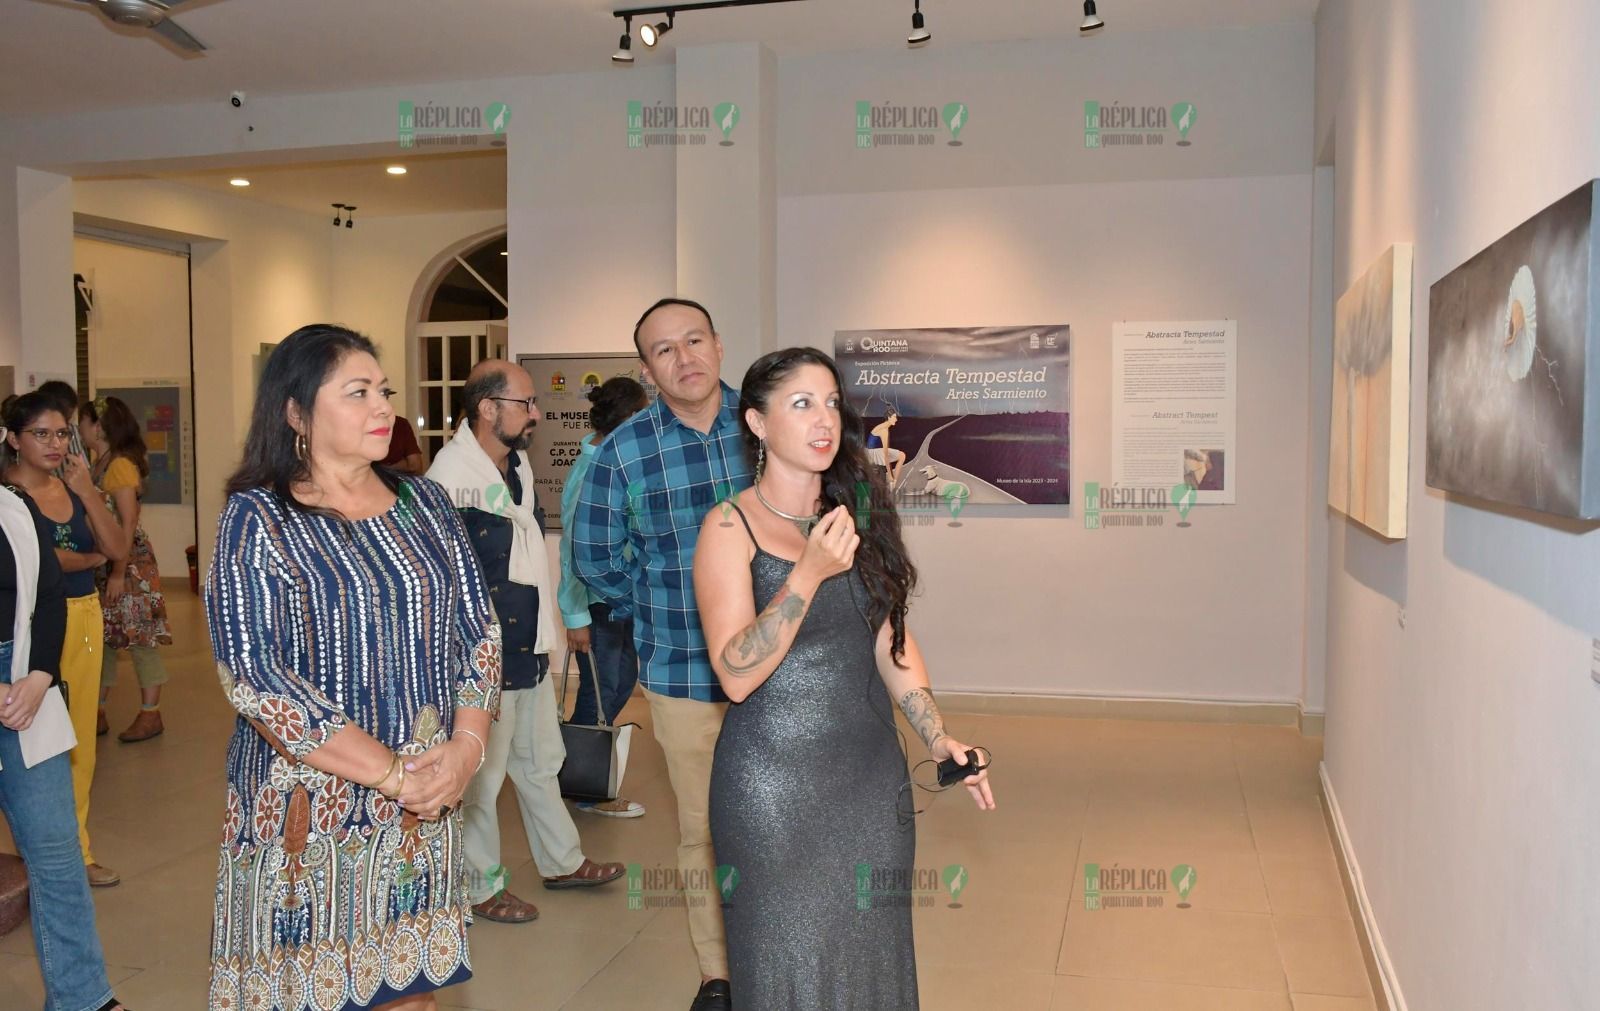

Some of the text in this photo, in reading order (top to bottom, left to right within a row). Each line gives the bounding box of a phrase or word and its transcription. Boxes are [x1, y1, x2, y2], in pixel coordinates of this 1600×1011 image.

[1145, 330, 1225, 339] Abstracta Tempestad
[855, 367, 1047, 386] Abstracta Tempestad
[946, 388, 1047, 400] Aries Sarmiento
[546, 411, 589, 420] EL MUSE
[549, 448, 582, 457] C.P. CA
[551, 459, 577, 467] JOA
